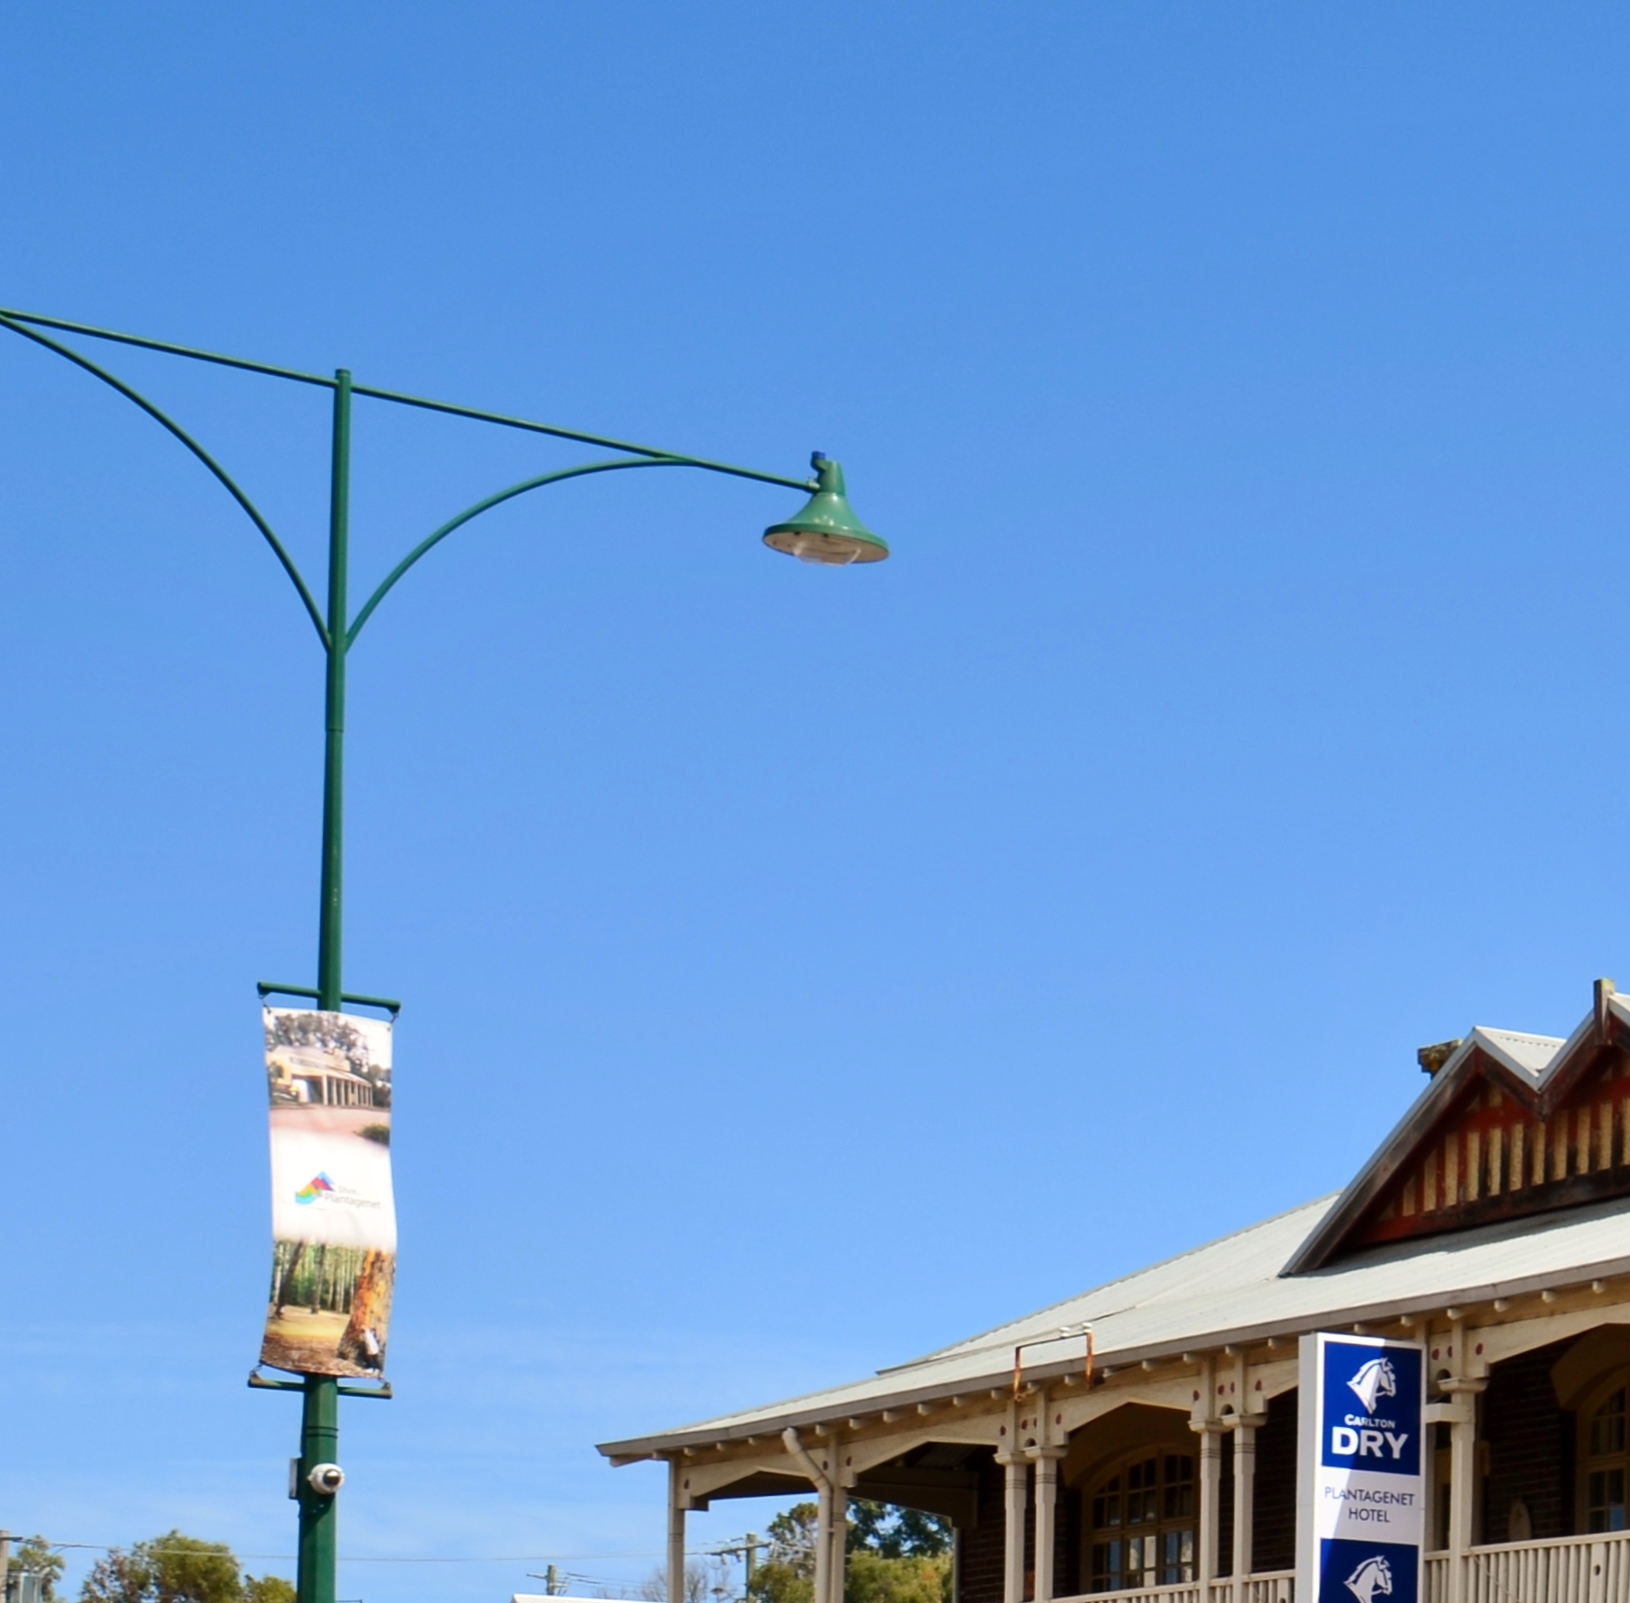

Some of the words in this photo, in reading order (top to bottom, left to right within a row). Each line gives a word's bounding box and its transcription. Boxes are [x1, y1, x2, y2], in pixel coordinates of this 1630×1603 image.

[1344, 1413, 1396, 1430] CARLTON
[1331, 1426, 1409, 1460] DRY
[1324, 1486, 1415, 1506] PLANTAGENET
[1348, 1507, 1390, 1523] HOTEL
